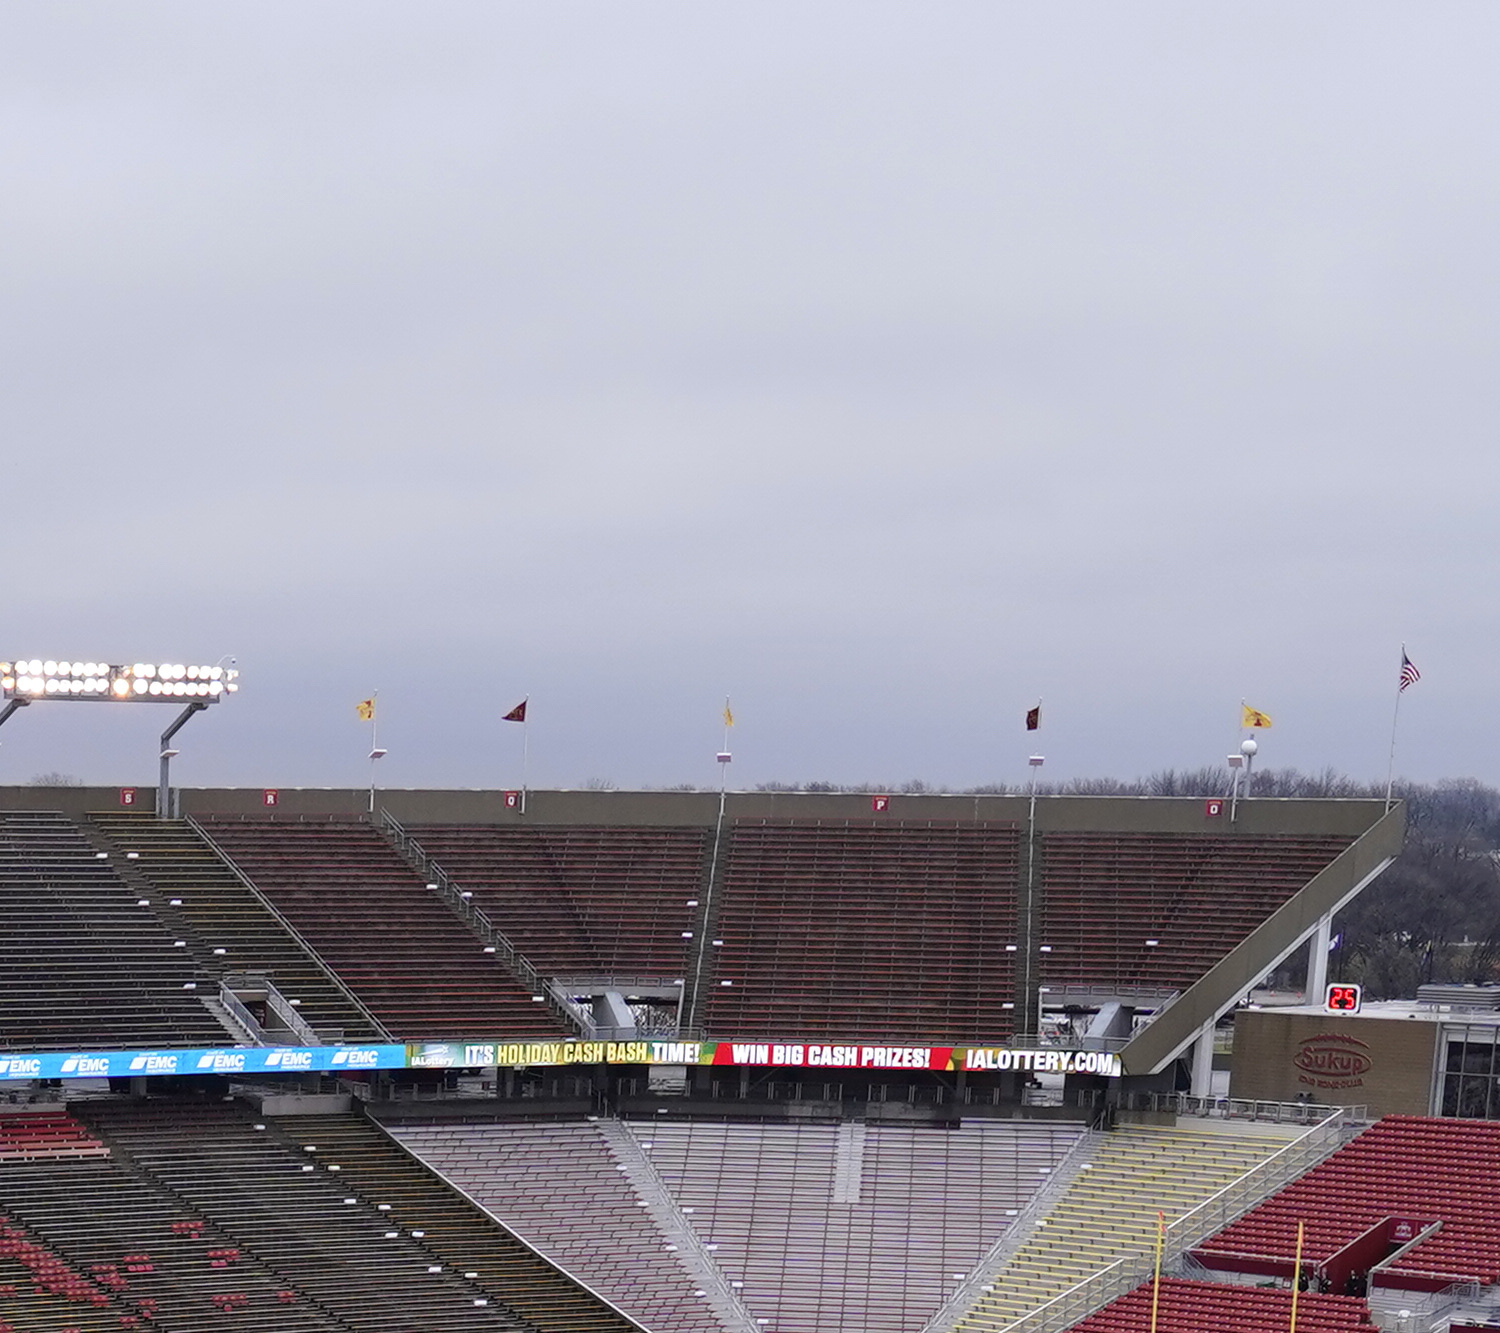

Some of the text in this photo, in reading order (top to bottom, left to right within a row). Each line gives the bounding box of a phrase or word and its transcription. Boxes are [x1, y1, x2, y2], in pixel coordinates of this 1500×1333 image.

[1331, 988, 1356, 1010] 25
[465, 1043, 700, 1064] IT'S HOLIDAY CASH BASH TIME!
[732, 1044, 931, 1069] WIN BIG CASH PRIZES!
[966, 1049, 1114, 1075] IALOTTERY.COM
[1301, 1047, 1363, 1075] Sukup
